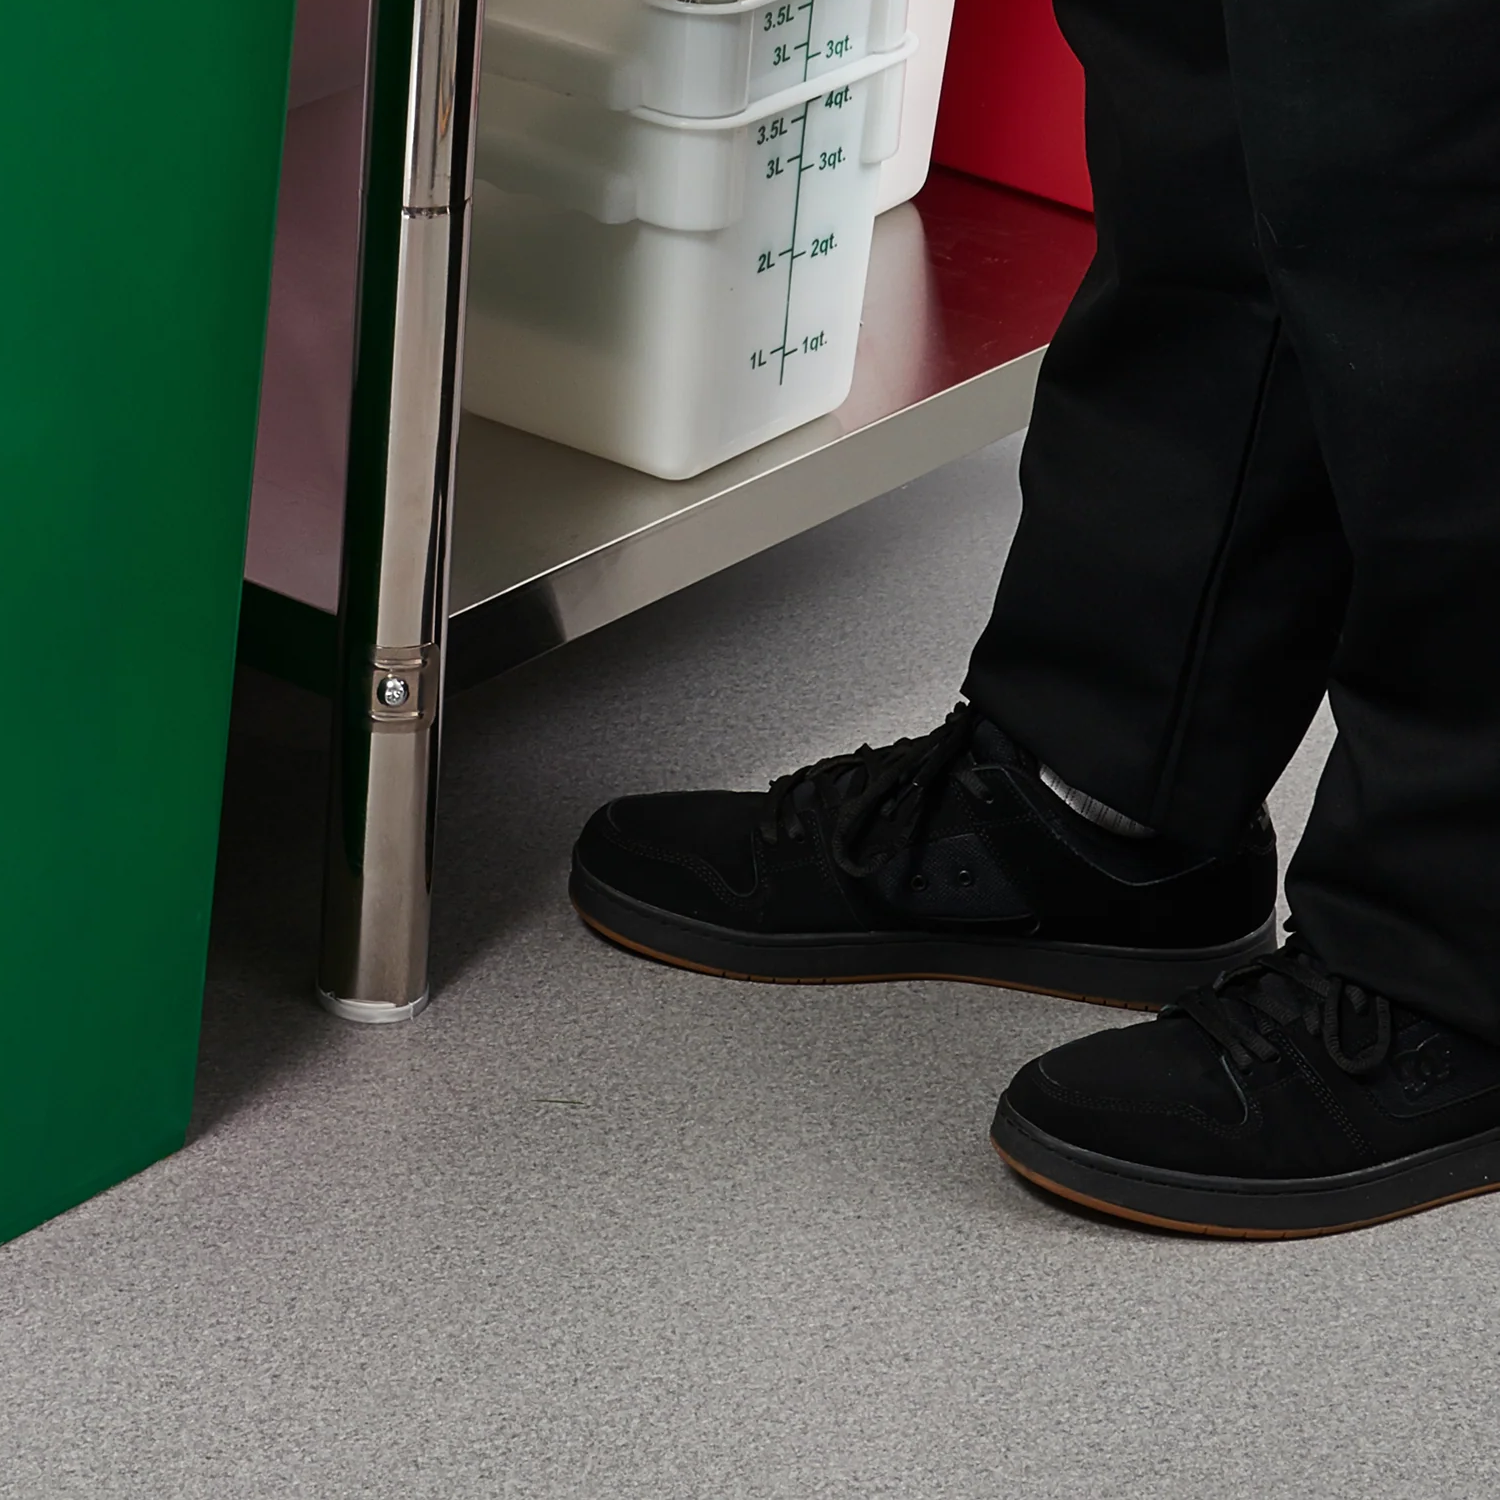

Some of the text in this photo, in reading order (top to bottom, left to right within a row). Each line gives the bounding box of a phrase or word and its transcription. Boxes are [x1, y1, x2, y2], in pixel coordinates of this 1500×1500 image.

[763, 4, 794, 31] 3.5L
[773, 44, 791, 66] 3L
[826, 35, 853, 59] 3qt.
[825, 86, 853, 109] 4qt.
[757, 118, 788, 145] 3.5L
[766, 159, 784, 179] 3L
[819, 147, 846, 170] 3qt.
[810, 233, 838, 258] 2qt.
[757, 251, 775, 274] 2L
[802, 330, 828, 354] 1qt.
[750, 350, 767, 369] 1L
